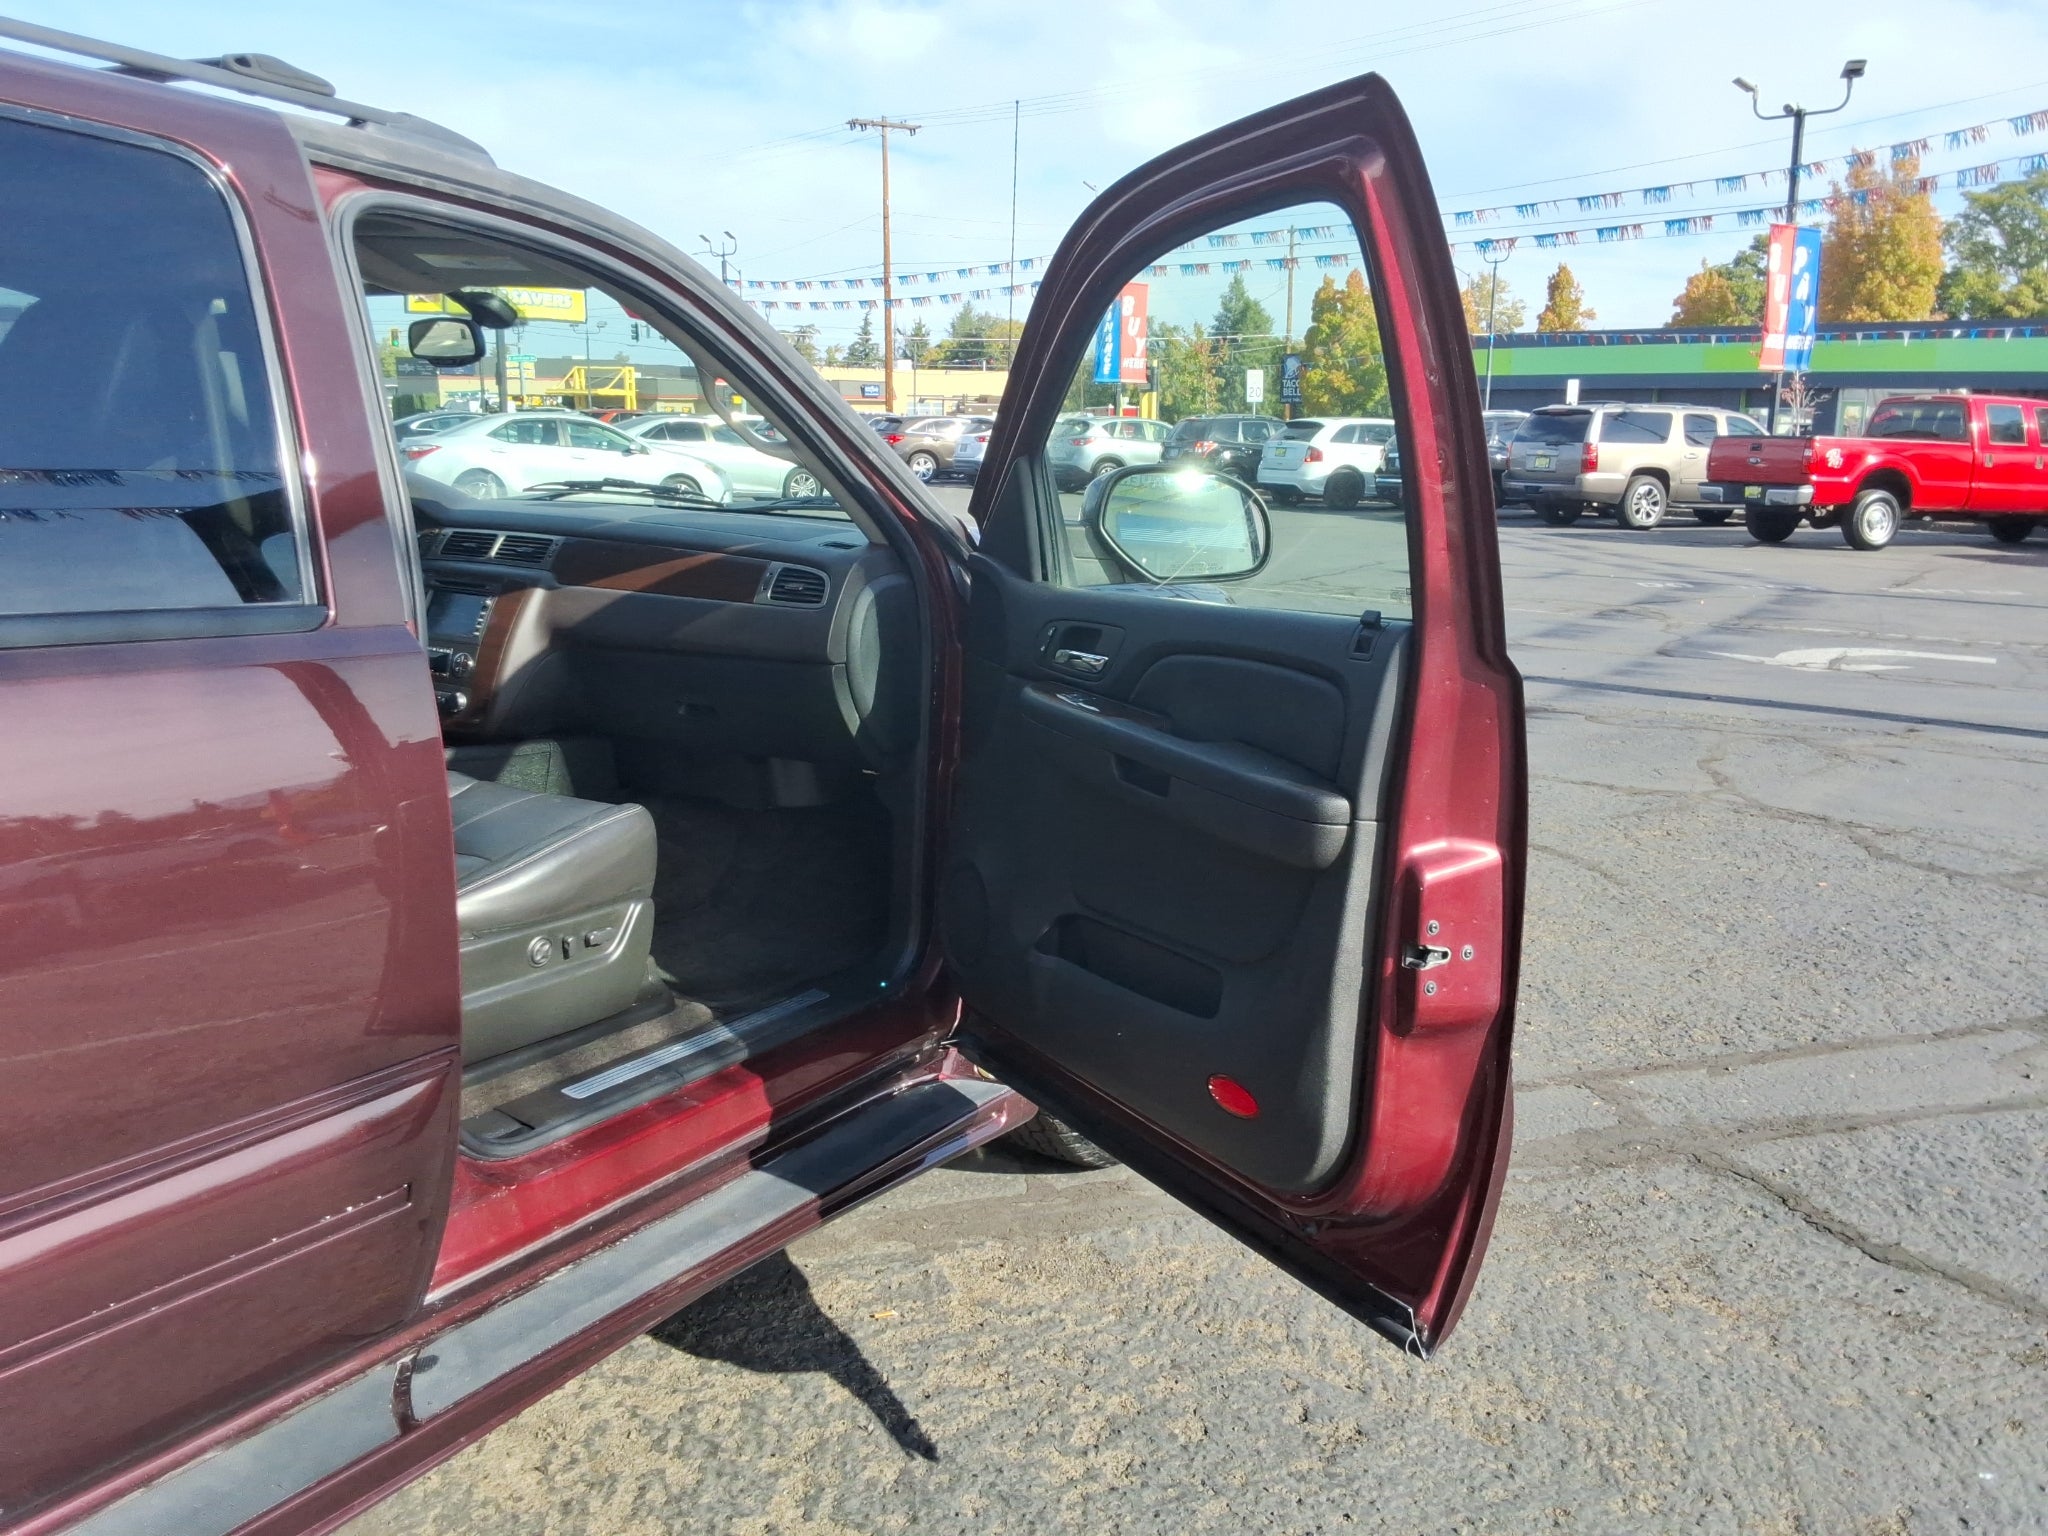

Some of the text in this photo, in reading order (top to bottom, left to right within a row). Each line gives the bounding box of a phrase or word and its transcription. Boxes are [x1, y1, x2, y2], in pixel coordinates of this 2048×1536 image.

[510, 290, 573, 308] SAVERS
[1769, 242, 1788, 332] BUY
[1793, 246, 1815, 333] PAY
[1102, 304, 1114, 375] INANCE
[1121, 295, 1147, 357] BUY
[1123, 357, 1147, 369] HERE
[1249, 386, 1262, 398] 20
[1283, 388, 1301, 396] BELL
